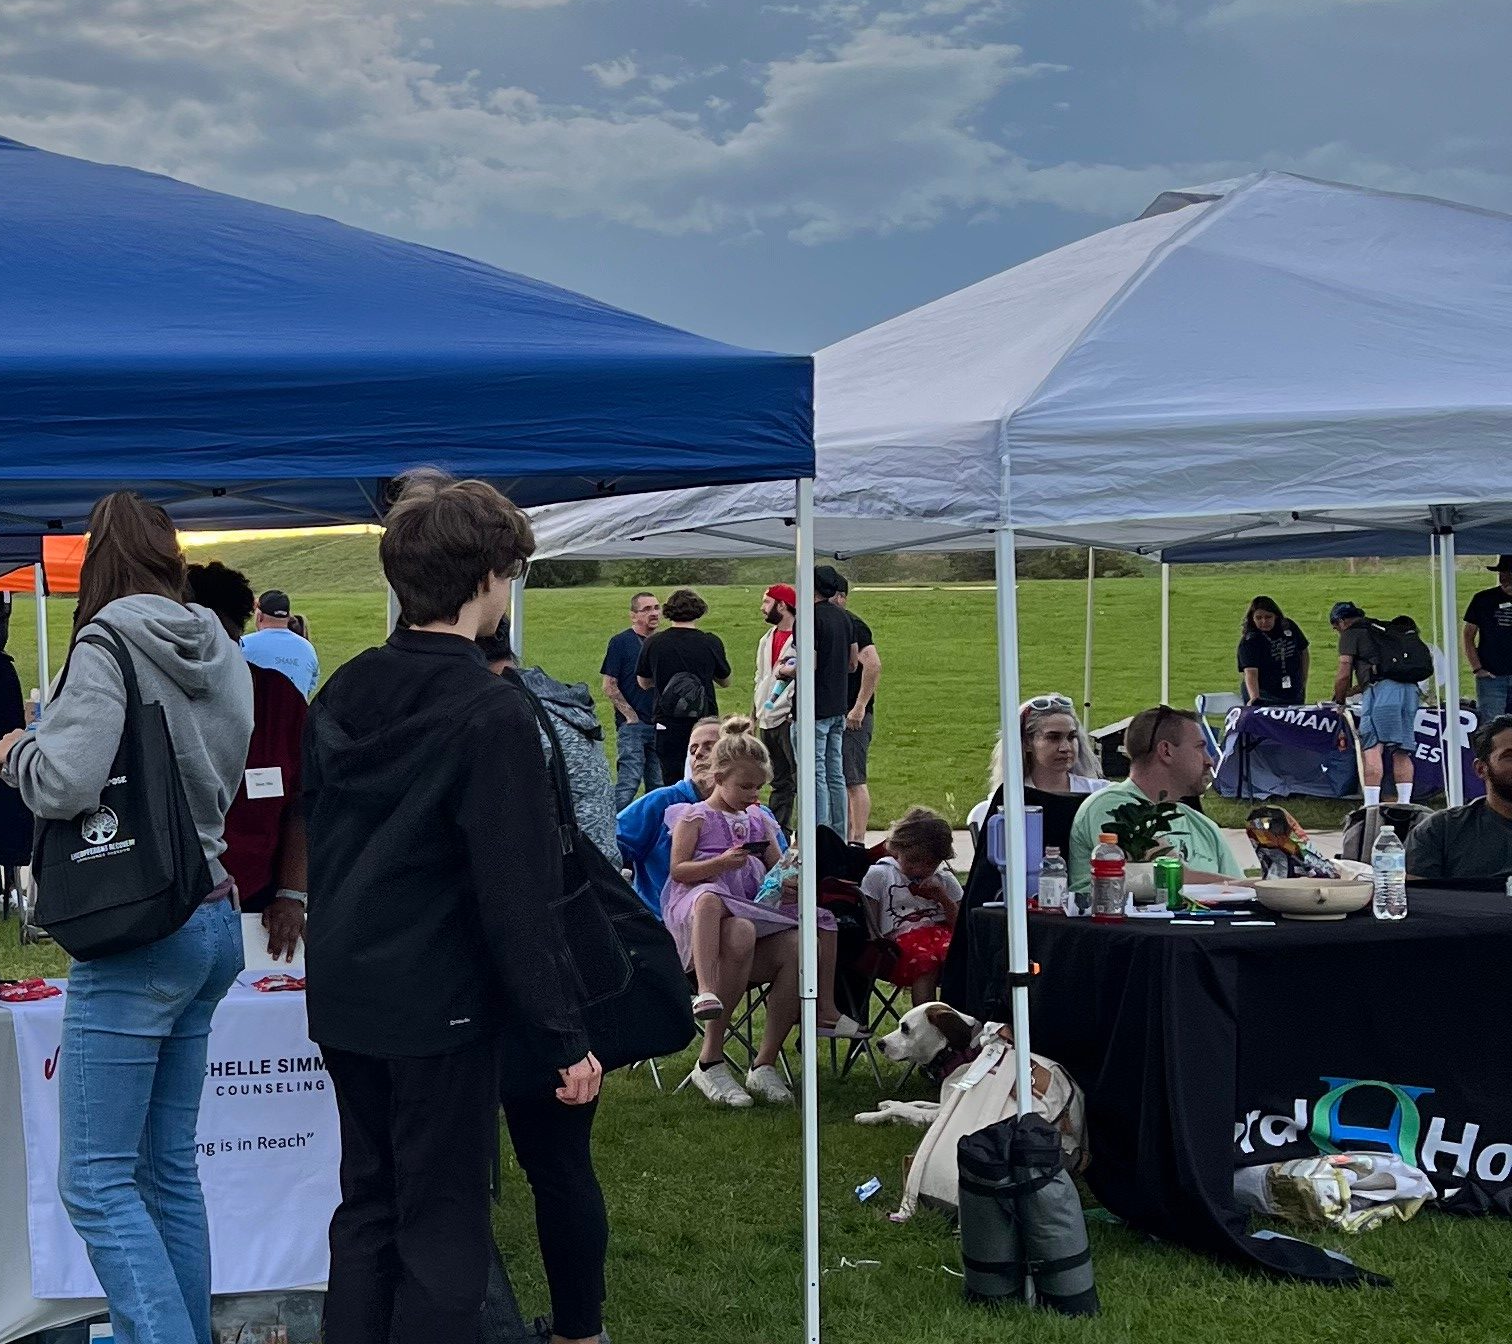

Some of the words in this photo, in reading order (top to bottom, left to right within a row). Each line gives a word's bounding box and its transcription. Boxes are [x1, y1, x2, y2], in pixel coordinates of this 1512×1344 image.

[205, 1059, 272, 1076] HELLE
[216, 1080, 325, 1096] COUNSELING
[220, 1138, 233, 1152] is
[237, 1138, 252, 1152] in
